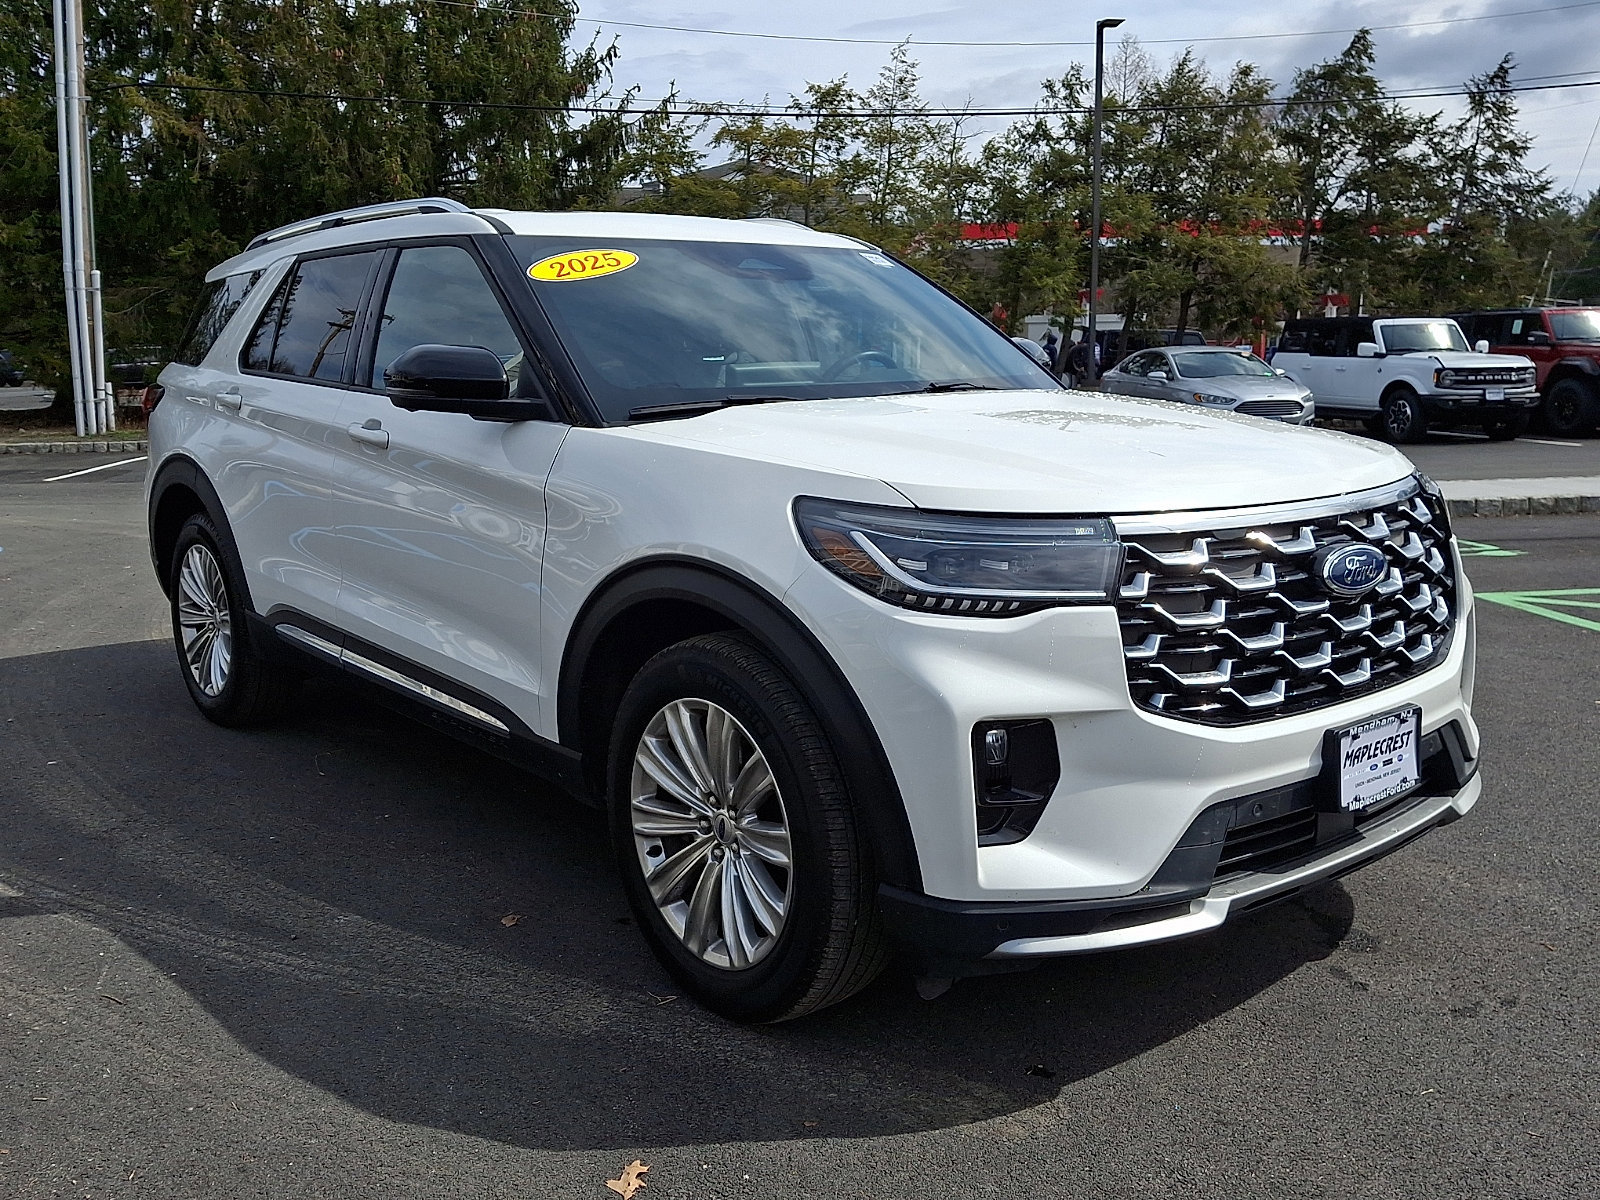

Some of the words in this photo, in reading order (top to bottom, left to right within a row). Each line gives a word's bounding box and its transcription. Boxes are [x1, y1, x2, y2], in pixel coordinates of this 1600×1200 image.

[549, 252, 621, 278] 2025
[1344, 555, 1378, 584] Ford
[1400, 709, 1413, 720] NJ
[1343, 730, 1413, 769] MAPLECREST
[1349, 780, 1416, 811] MaplecrestFord.com
